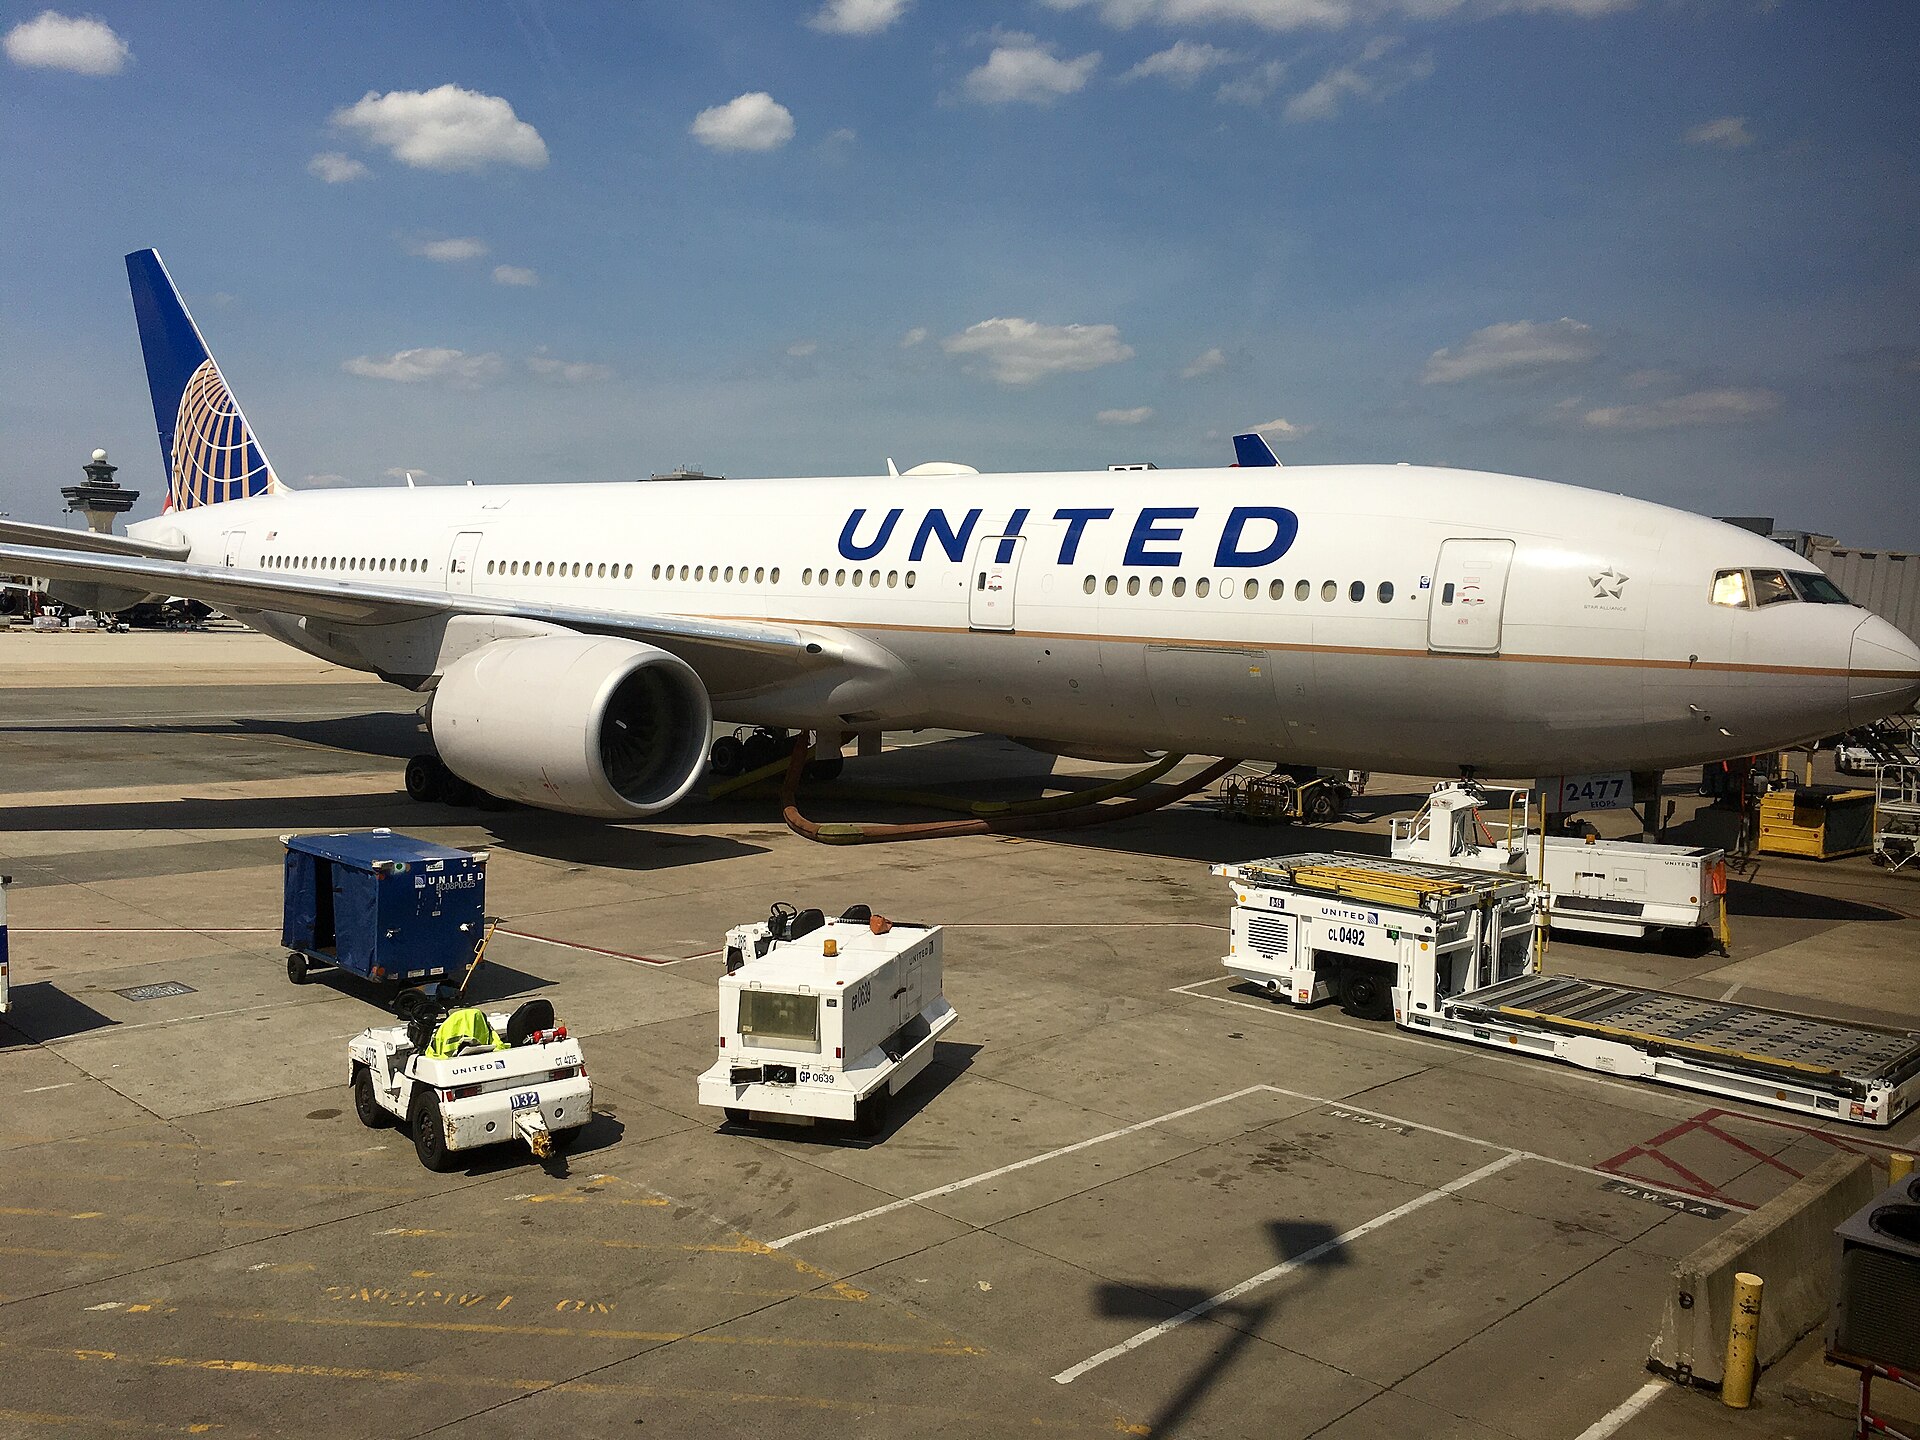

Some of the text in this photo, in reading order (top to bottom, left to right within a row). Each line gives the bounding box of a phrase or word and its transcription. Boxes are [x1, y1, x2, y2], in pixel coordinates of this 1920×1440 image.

[837, 506, 1299, 568] UNITED
[1565, 779, 1624, 802] 2477
[1590, 800, 1617, 808] ETOPS
[428, 872, 484, 885] UNITED
[1321, 907, 1365, 921] UNITED
[1328, 926, 1365, 947] CL 0492
[563, 1054, 578, 1065] 4275
[452, 1063, 493, 1075] UNITED
[799, 1070, 834, 1084] GP 0639
[512, 1092, 538, 1108] D32
